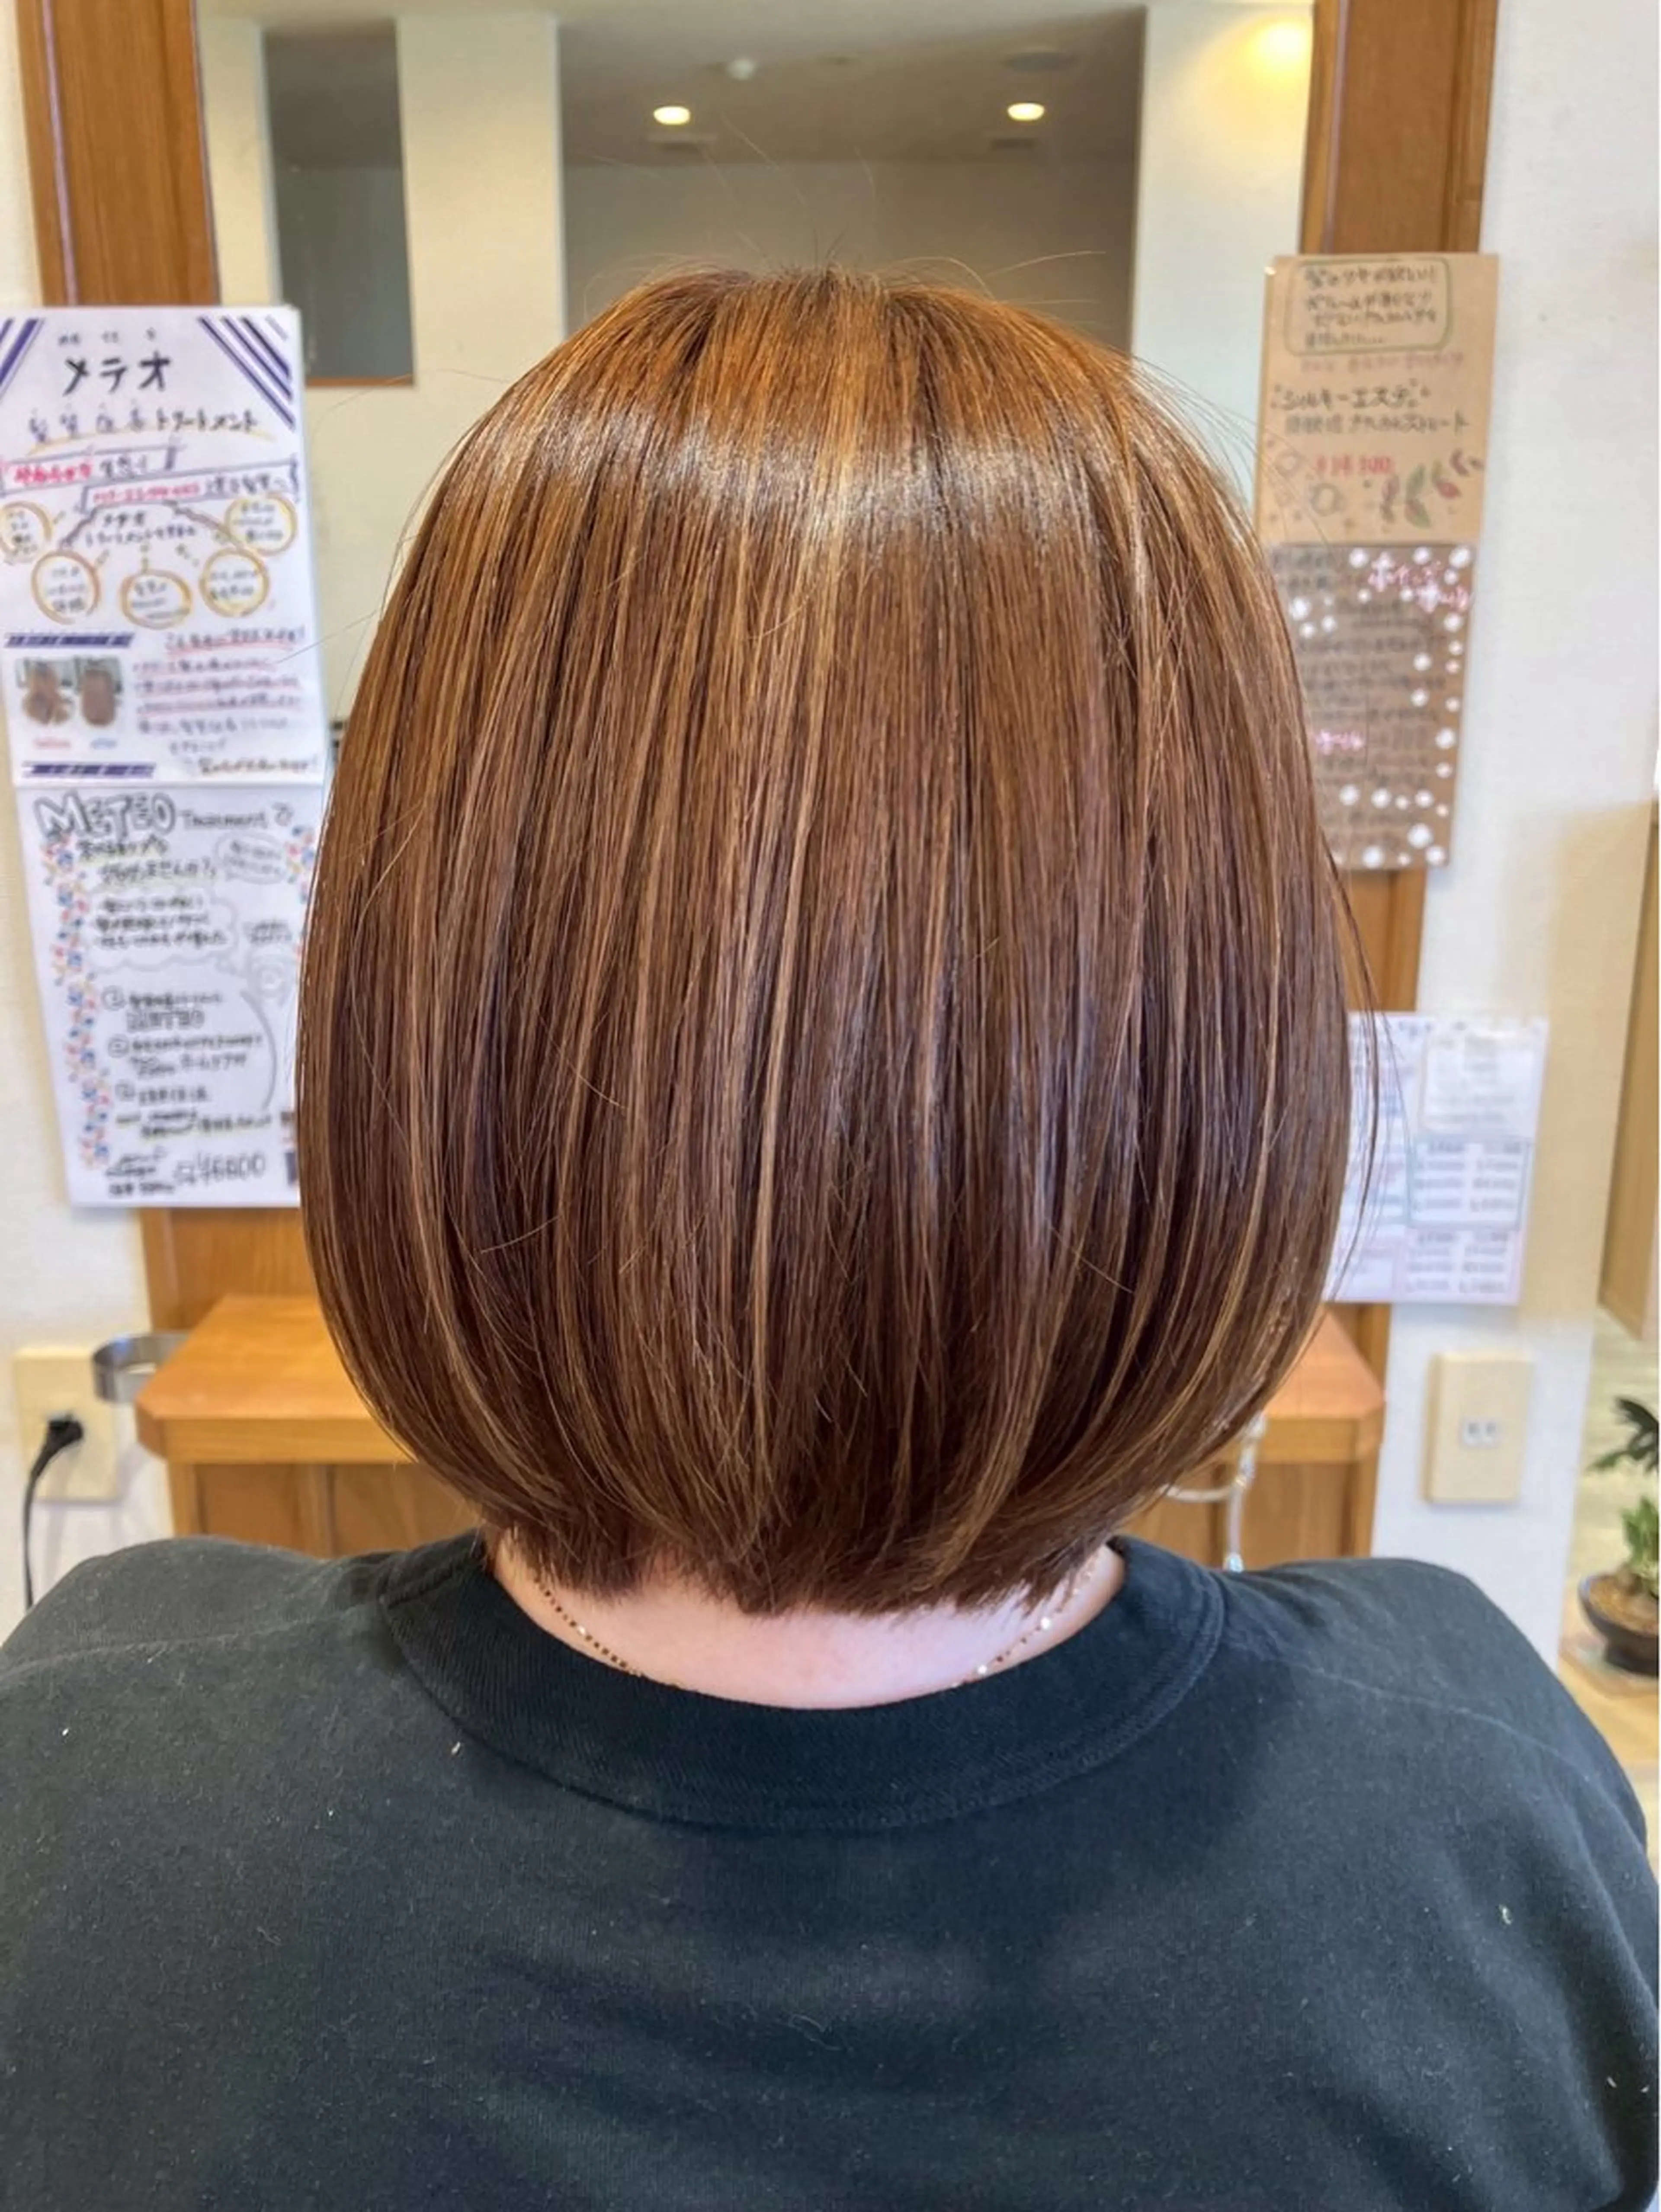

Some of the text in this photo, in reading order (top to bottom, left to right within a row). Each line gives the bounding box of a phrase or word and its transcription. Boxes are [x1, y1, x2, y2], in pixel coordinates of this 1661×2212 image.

[62, 349, 173, 397] メテオ
[34, 789, 176, 839] METEO
